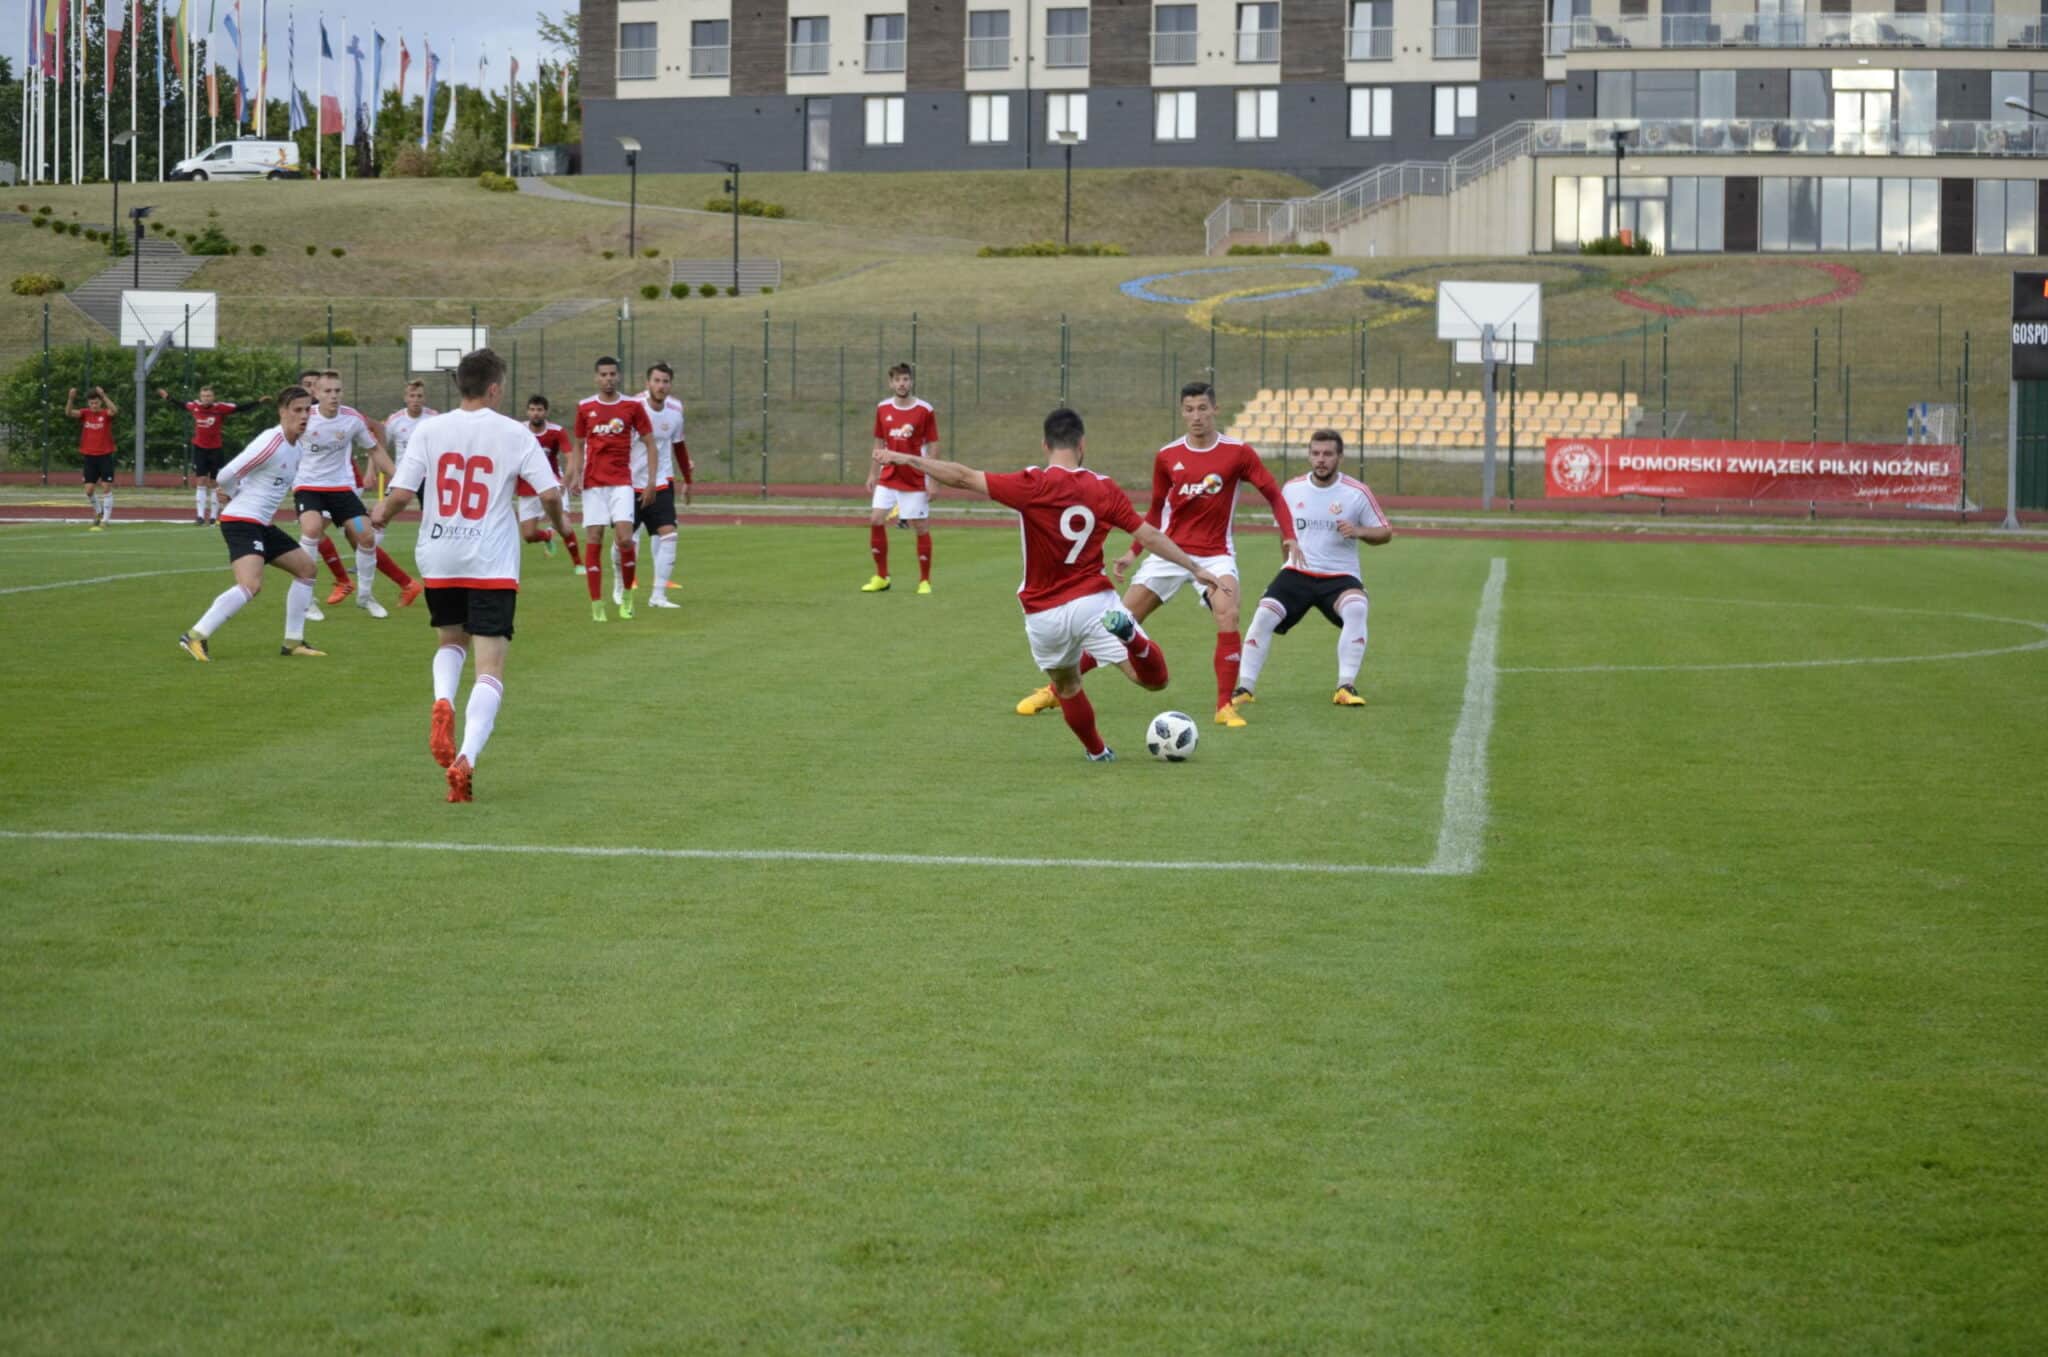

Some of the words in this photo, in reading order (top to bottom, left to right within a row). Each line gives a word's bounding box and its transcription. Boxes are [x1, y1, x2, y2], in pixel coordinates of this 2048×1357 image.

[436, 451, 494, 521] 66
[1618, 455, 1722, 472] POMORSKI
[1726, 457, 1815, 477] ZWIĄZEK
[1819, 458, 1868, 475] PIŁKI
[1872, 457, 1950, 477] NOŻNEJ
[1060, 505, 1095, 564] 9
